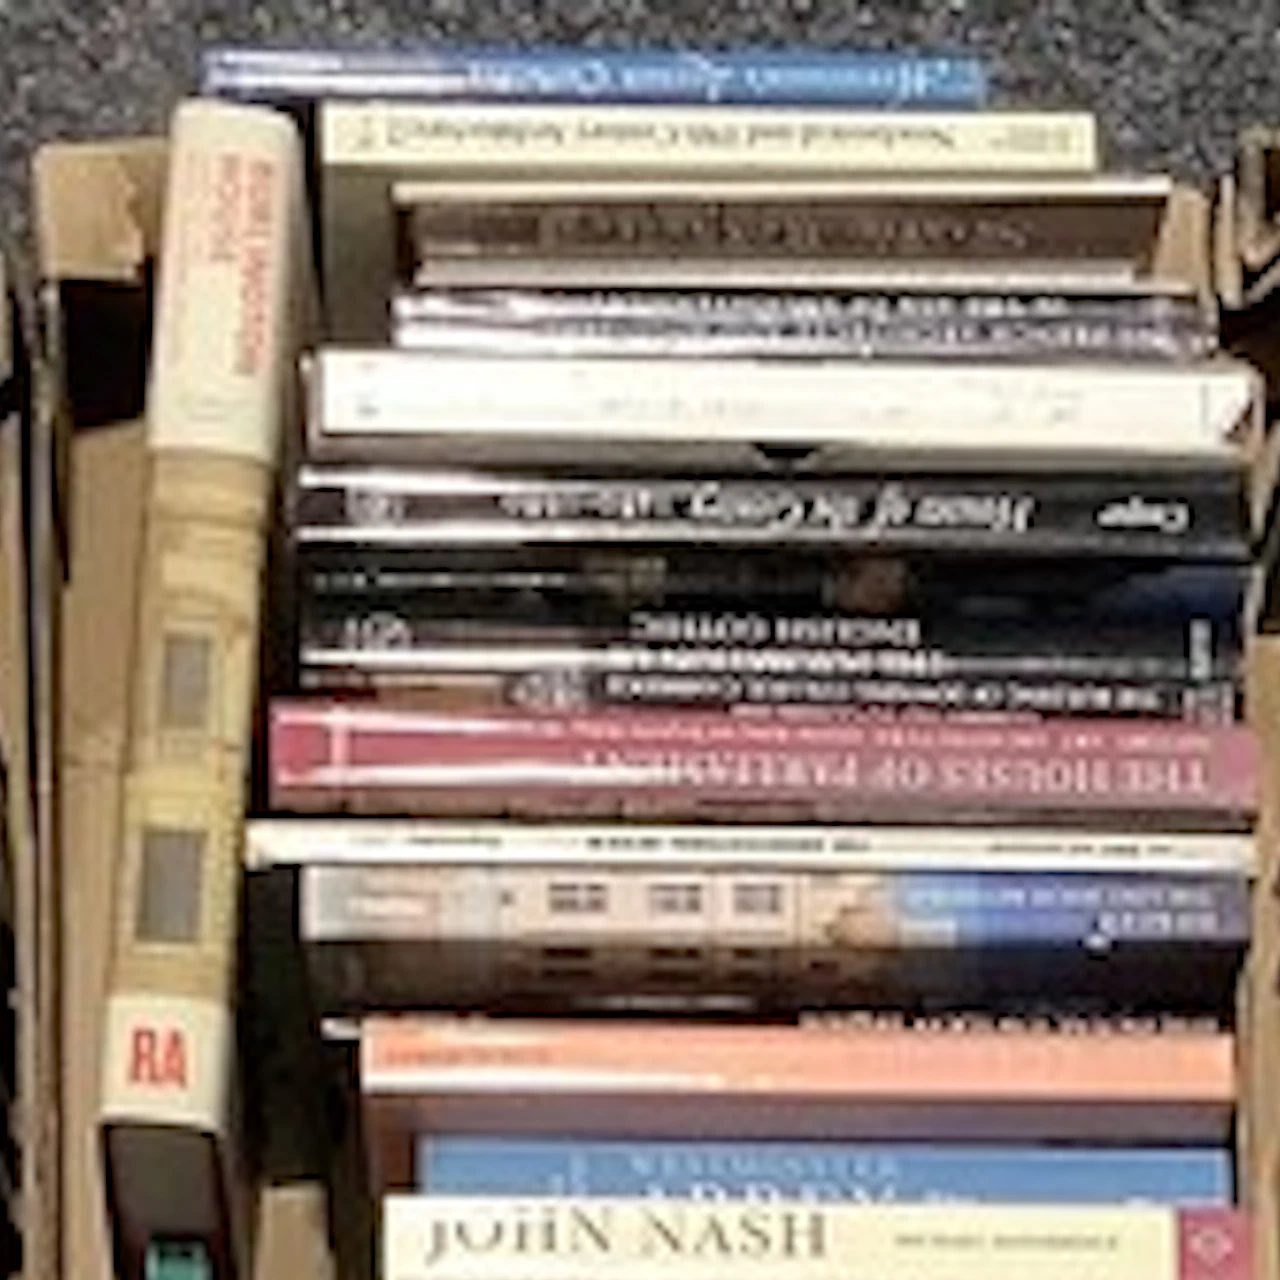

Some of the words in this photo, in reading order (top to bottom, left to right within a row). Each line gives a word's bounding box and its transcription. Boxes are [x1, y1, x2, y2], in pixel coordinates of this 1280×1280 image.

[878, 757, 930, 791] OF
[940, 757, 1111, 794] HOUSES
[1114, 757, 1208, 794] THE
[126, 1025, 188, 1090] RA
[425, 1209, 617, 1265] JOHN
[642, 1211, 829, 1260] NASH
